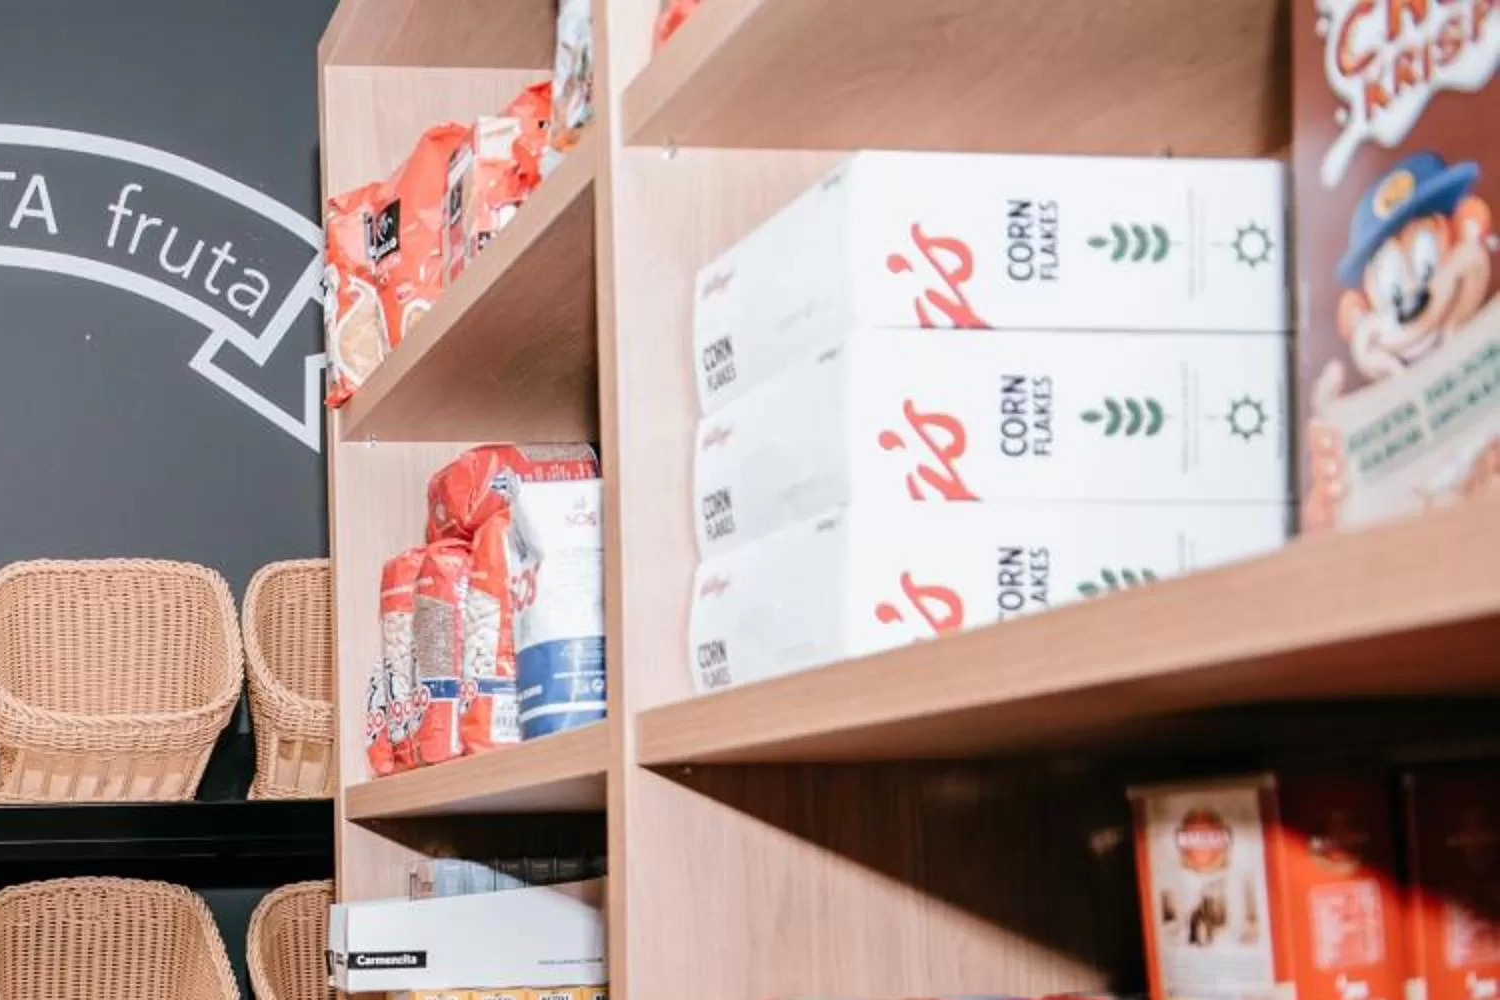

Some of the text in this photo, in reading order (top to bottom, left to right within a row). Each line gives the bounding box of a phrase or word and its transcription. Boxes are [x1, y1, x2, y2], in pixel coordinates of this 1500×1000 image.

[105, 184, 273, 318] fruta
[1007, 200, 1034, 281] CORN
[1039, 200, 1059, 281] FLAKES
[1000, 374, 1028, 457] CORN
[1033, 375, 1054, 457] FLAKES
[1030, 546, 1050, 608] AKES
